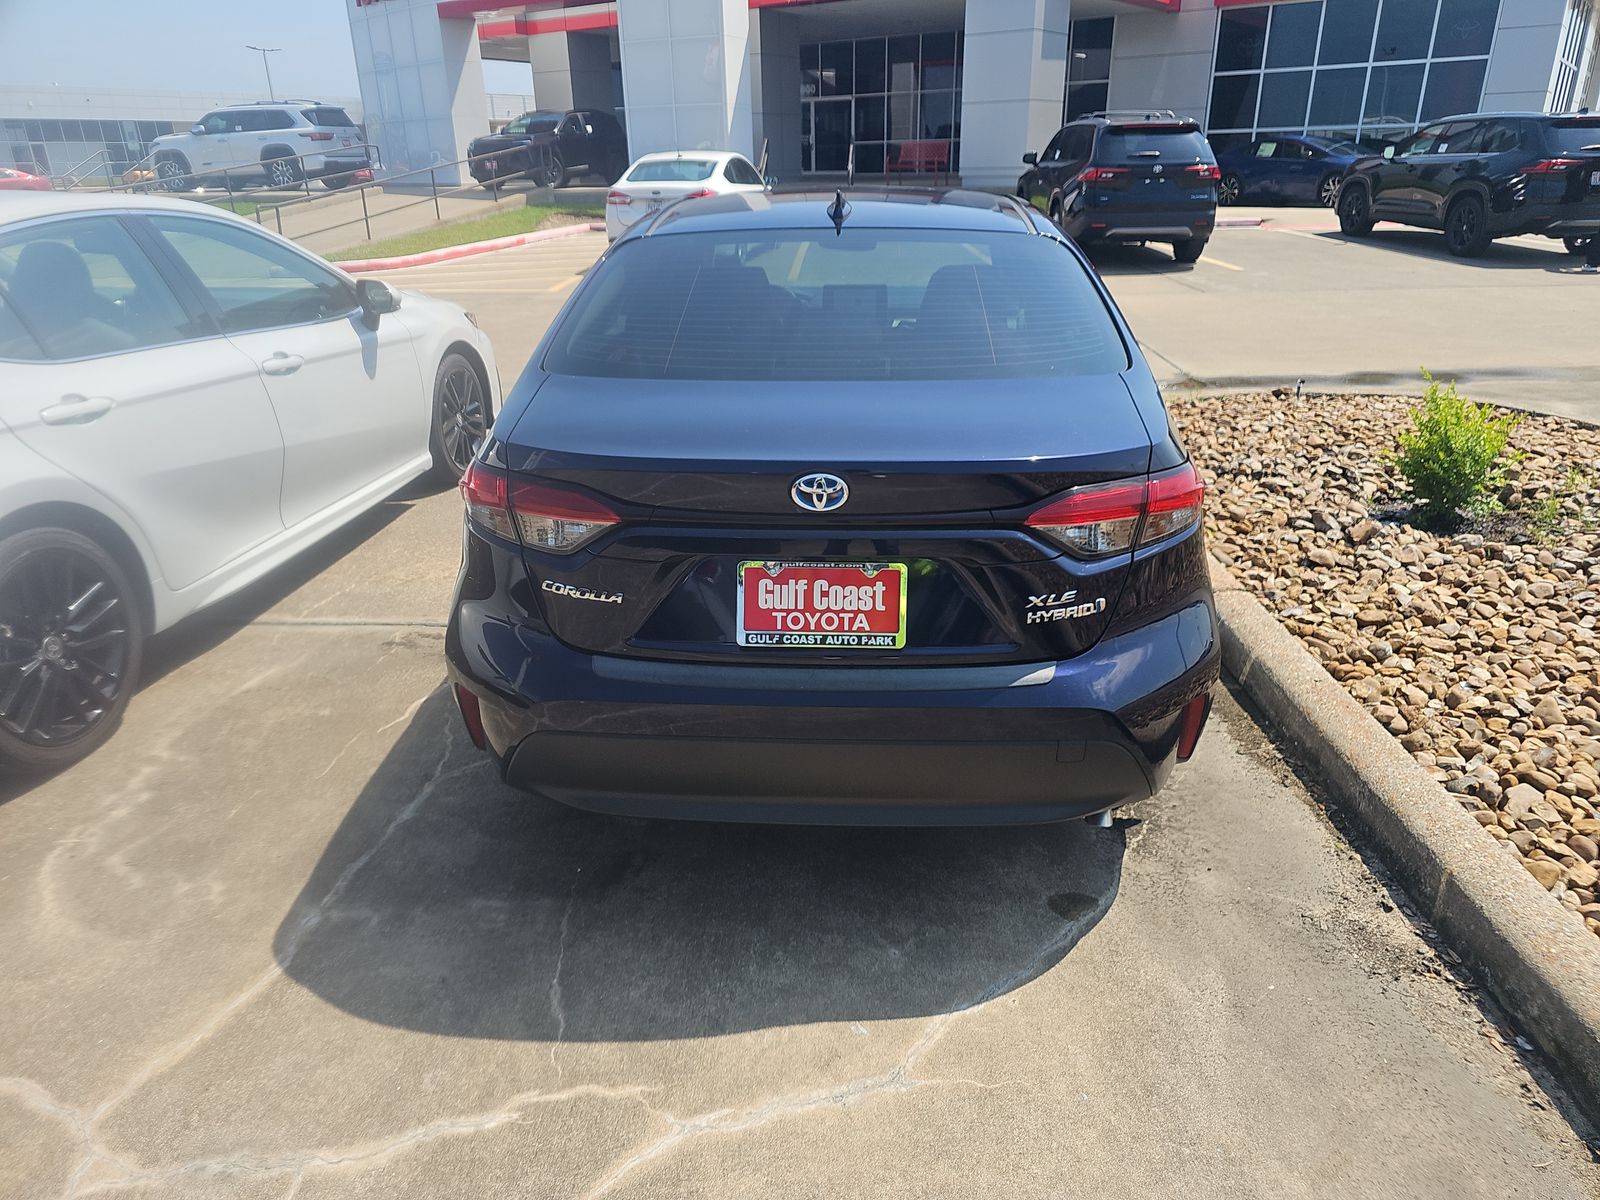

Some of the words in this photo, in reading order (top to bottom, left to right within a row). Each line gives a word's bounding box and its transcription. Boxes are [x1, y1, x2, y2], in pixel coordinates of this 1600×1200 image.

[541, 580, 624, 604] COROLLA
[758, 578, 808, 610] Gulf
[813, 579, 886, 611] Coast
[1025, 590, 1078, 608] XLE
[772, 611, 871, 632] TOYOTA
[1026, 602, 1097, 624] HYBRID
[748, 634, 780, 644] GULF
[783, 635, 822, 645] COAST
[825, 635, 858, 645] AUTO
[861, 636, 893, 646] PARK
